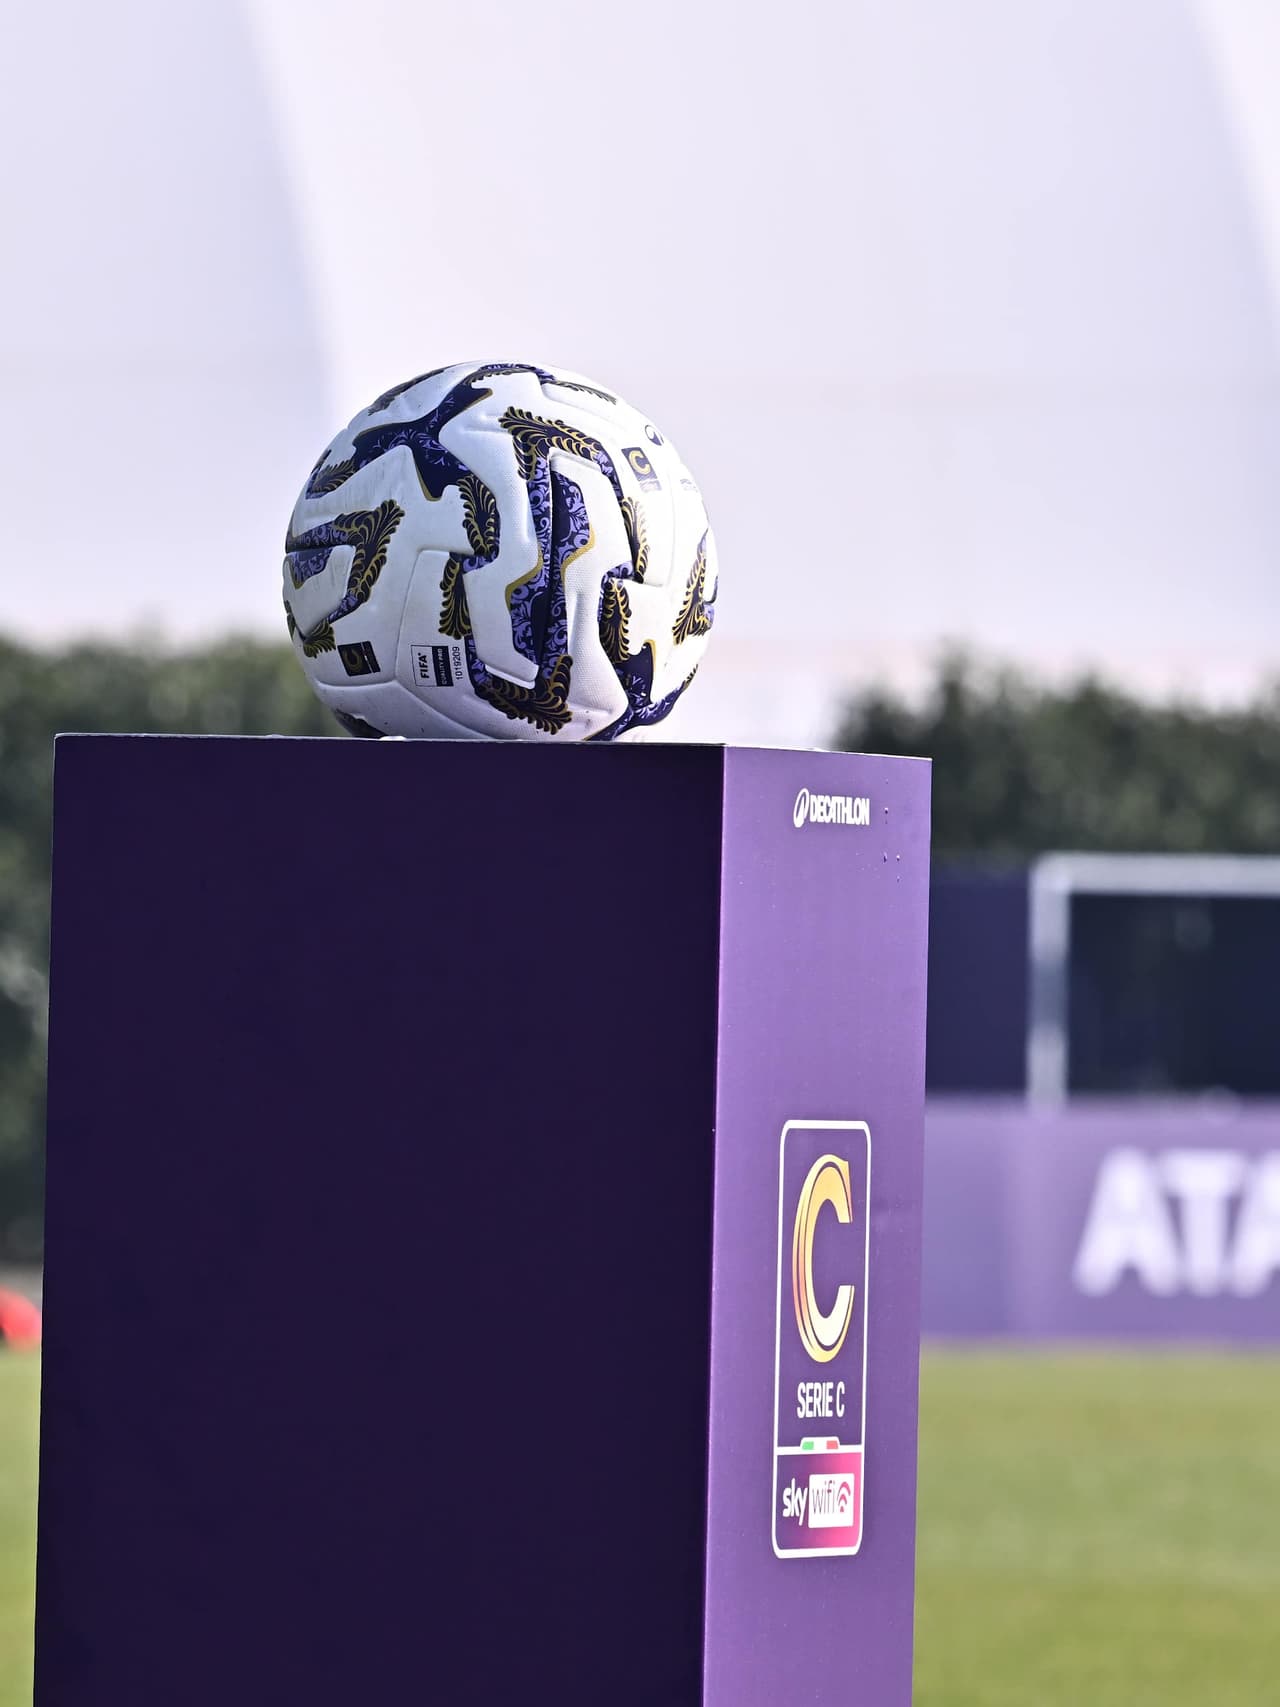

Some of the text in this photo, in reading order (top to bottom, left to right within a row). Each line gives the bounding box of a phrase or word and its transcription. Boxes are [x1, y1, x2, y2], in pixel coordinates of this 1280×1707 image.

[628, 450, 651, 475] C
[418, 653, 429, 679] FIFA
[452, 646, 463, 680] 1019209
[809, 795, 870, 825] DECATHLON
[792, 1154, 855, 1363] C
[797, 1381, 845, 1418] SERIE C
[782, 1477, 836, 1526] sky wifi
